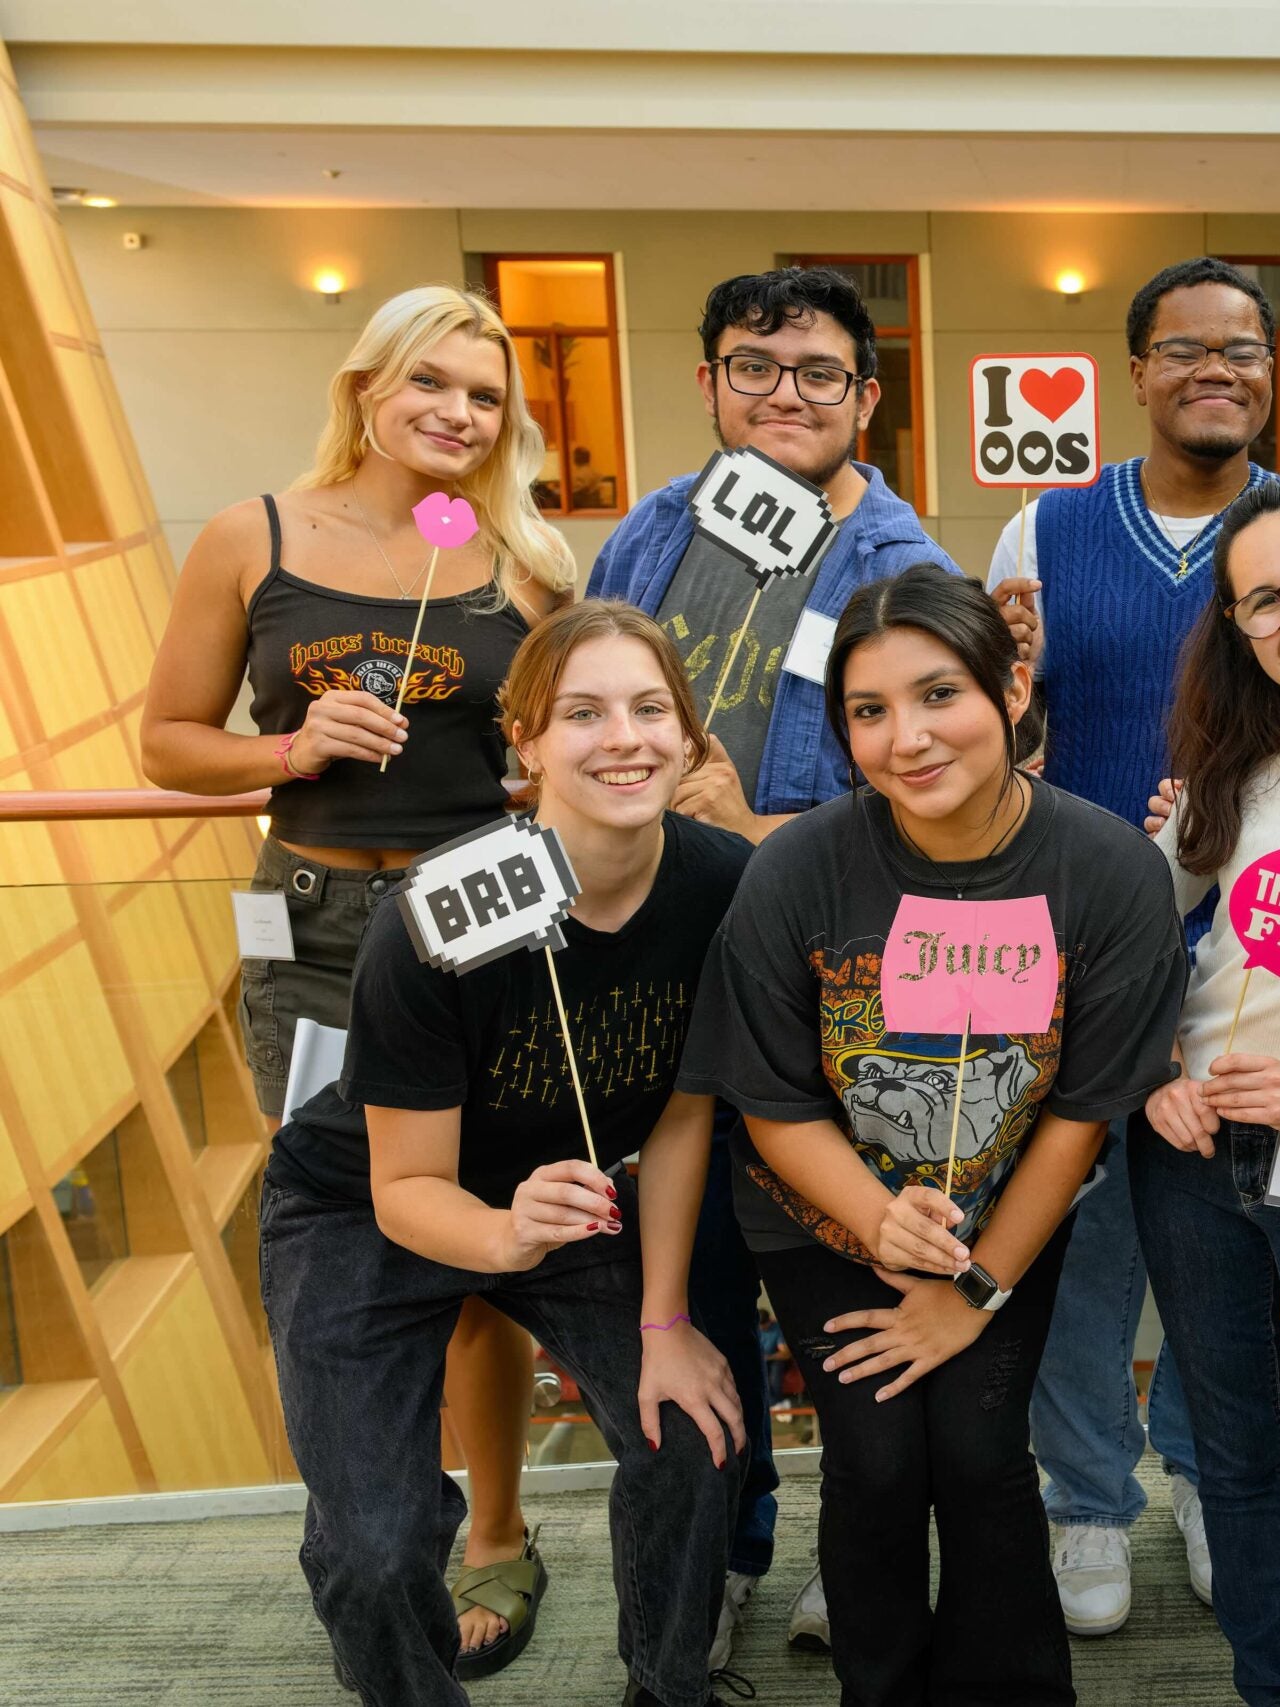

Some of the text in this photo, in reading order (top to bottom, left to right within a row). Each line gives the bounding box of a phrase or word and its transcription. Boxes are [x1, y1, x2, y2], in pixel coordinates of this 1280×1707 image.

[982, 366, 1013, 428] I
[980, 431, 1090, 476] OOS
[711, 470, 796, 557] LOL
[290, 631, 466, 678] hogs breath
[425, 853, 546, 944] BRB
[898, 931, 1041, 984] Juicy
